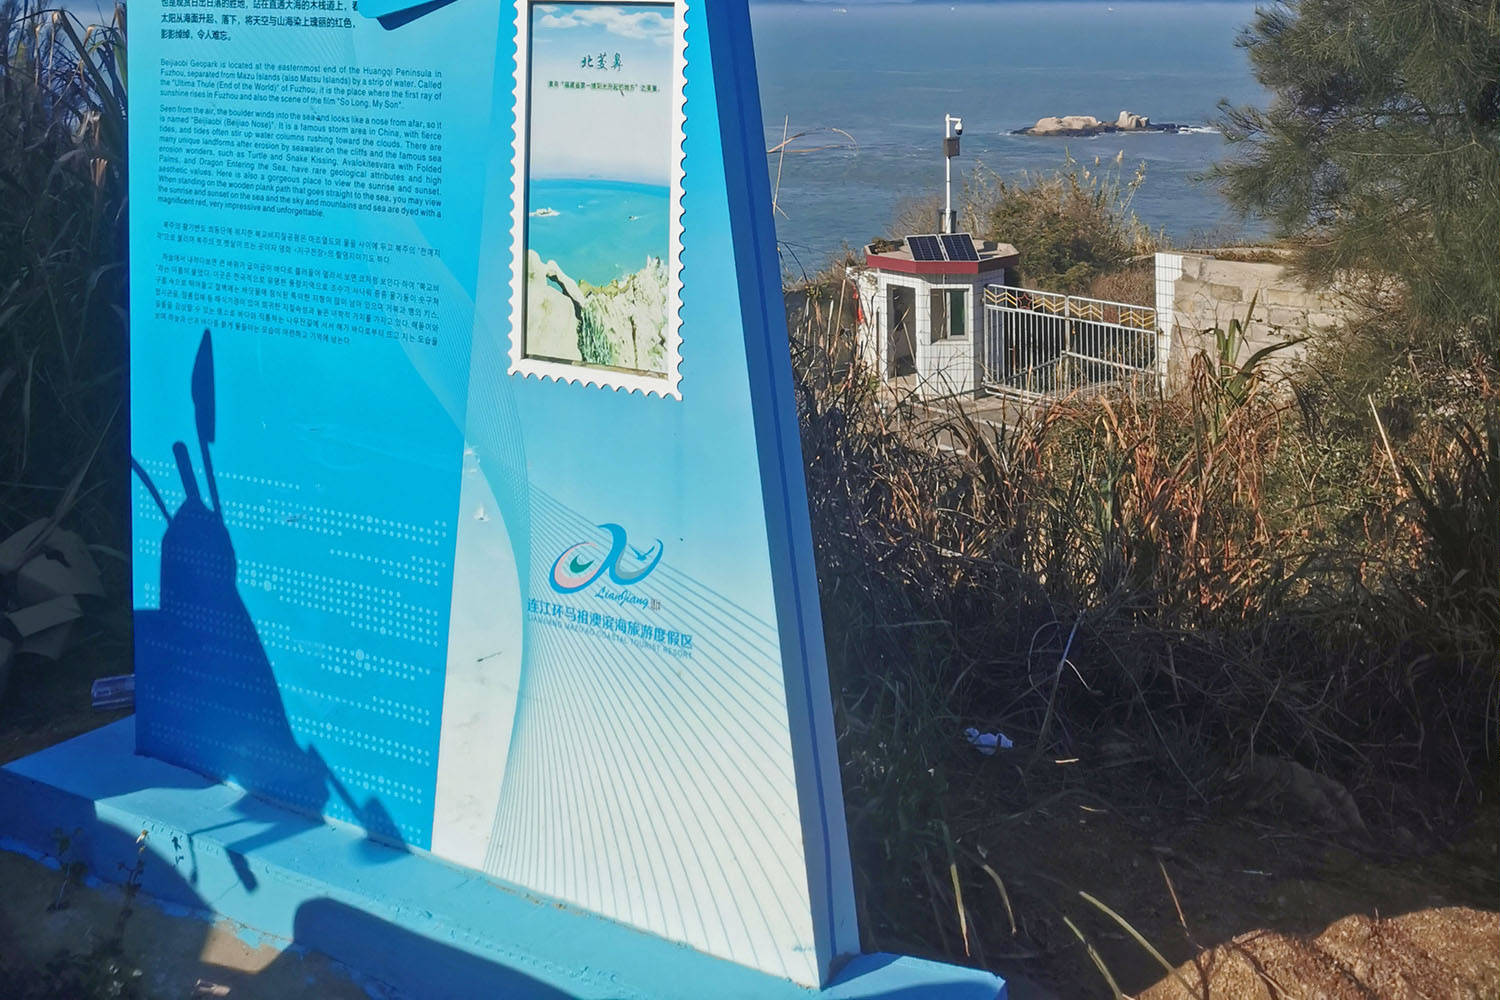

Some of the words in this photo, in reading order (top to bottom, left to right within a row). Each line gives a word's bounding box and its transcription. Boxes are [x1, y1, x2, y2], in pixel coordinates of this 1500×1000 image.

[418, 80, 441, 88] Called
[405, 90, 418, 98] first
[421, 131, 441, 139] fierce
[406, 141, 426, 149] There
[399, 151, 425, 160] famous
[416, 163, 441, 172] Folded
[408, 174, 422, 182] and
[425, 175, 441, 185] high
[408, 197, 422, 206] may
[425, 197, 441, 205] view
[420, 208, 434, 216] with
